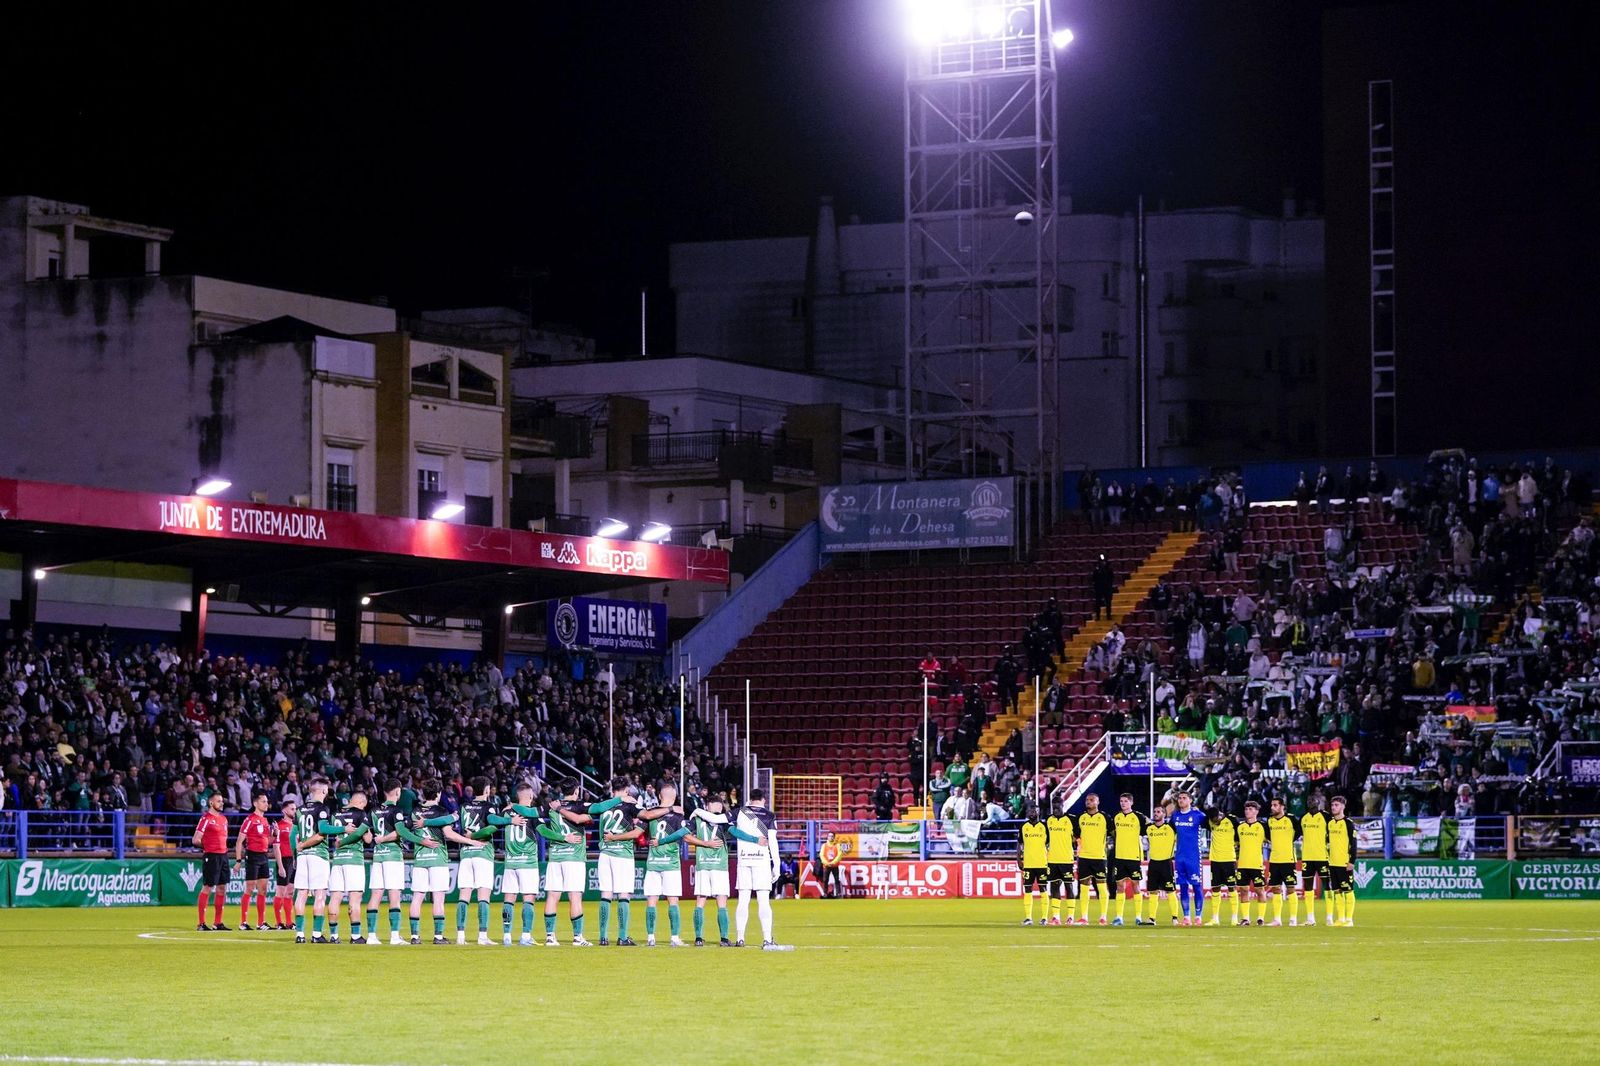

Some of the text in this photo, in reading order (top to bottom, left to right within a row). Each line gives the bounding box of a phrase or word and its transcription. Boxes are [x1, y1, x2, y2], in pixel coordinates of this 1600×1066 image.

[863, 485, 960, 512] Montanera
[159, 501, 327, 540] JUNTA DE EXTREMADURA
[869, 524, 881, 536] de
[883, 523, 892, 535] la
[899, 512, 955, 534] Dehesa
[586, 543, 648, 573] Kappa
[588, 604, 656, 636] ENERGAL
[299, 814, 314, 838] 19
[377, 817, 385, 836] 9
[463, 812, 481, 832] 14
[509, 820, 526, 842] 10
[603, 809, 624, 834] 22
[656, 820, 667, 840] 8
[1382, 866, 1477, 878] CAJA RURAL DE
[1523, 864, 1600, 874] CERVEZAS
[42, 867, 153, 897] Mercoguadiana
[902, 887, 913, 896] &
[917, 887, 947, 896] Pvc
[1382, 878, 1484, 889] EXTREMADURA
[97, 891, 151, 906] Agricentros
